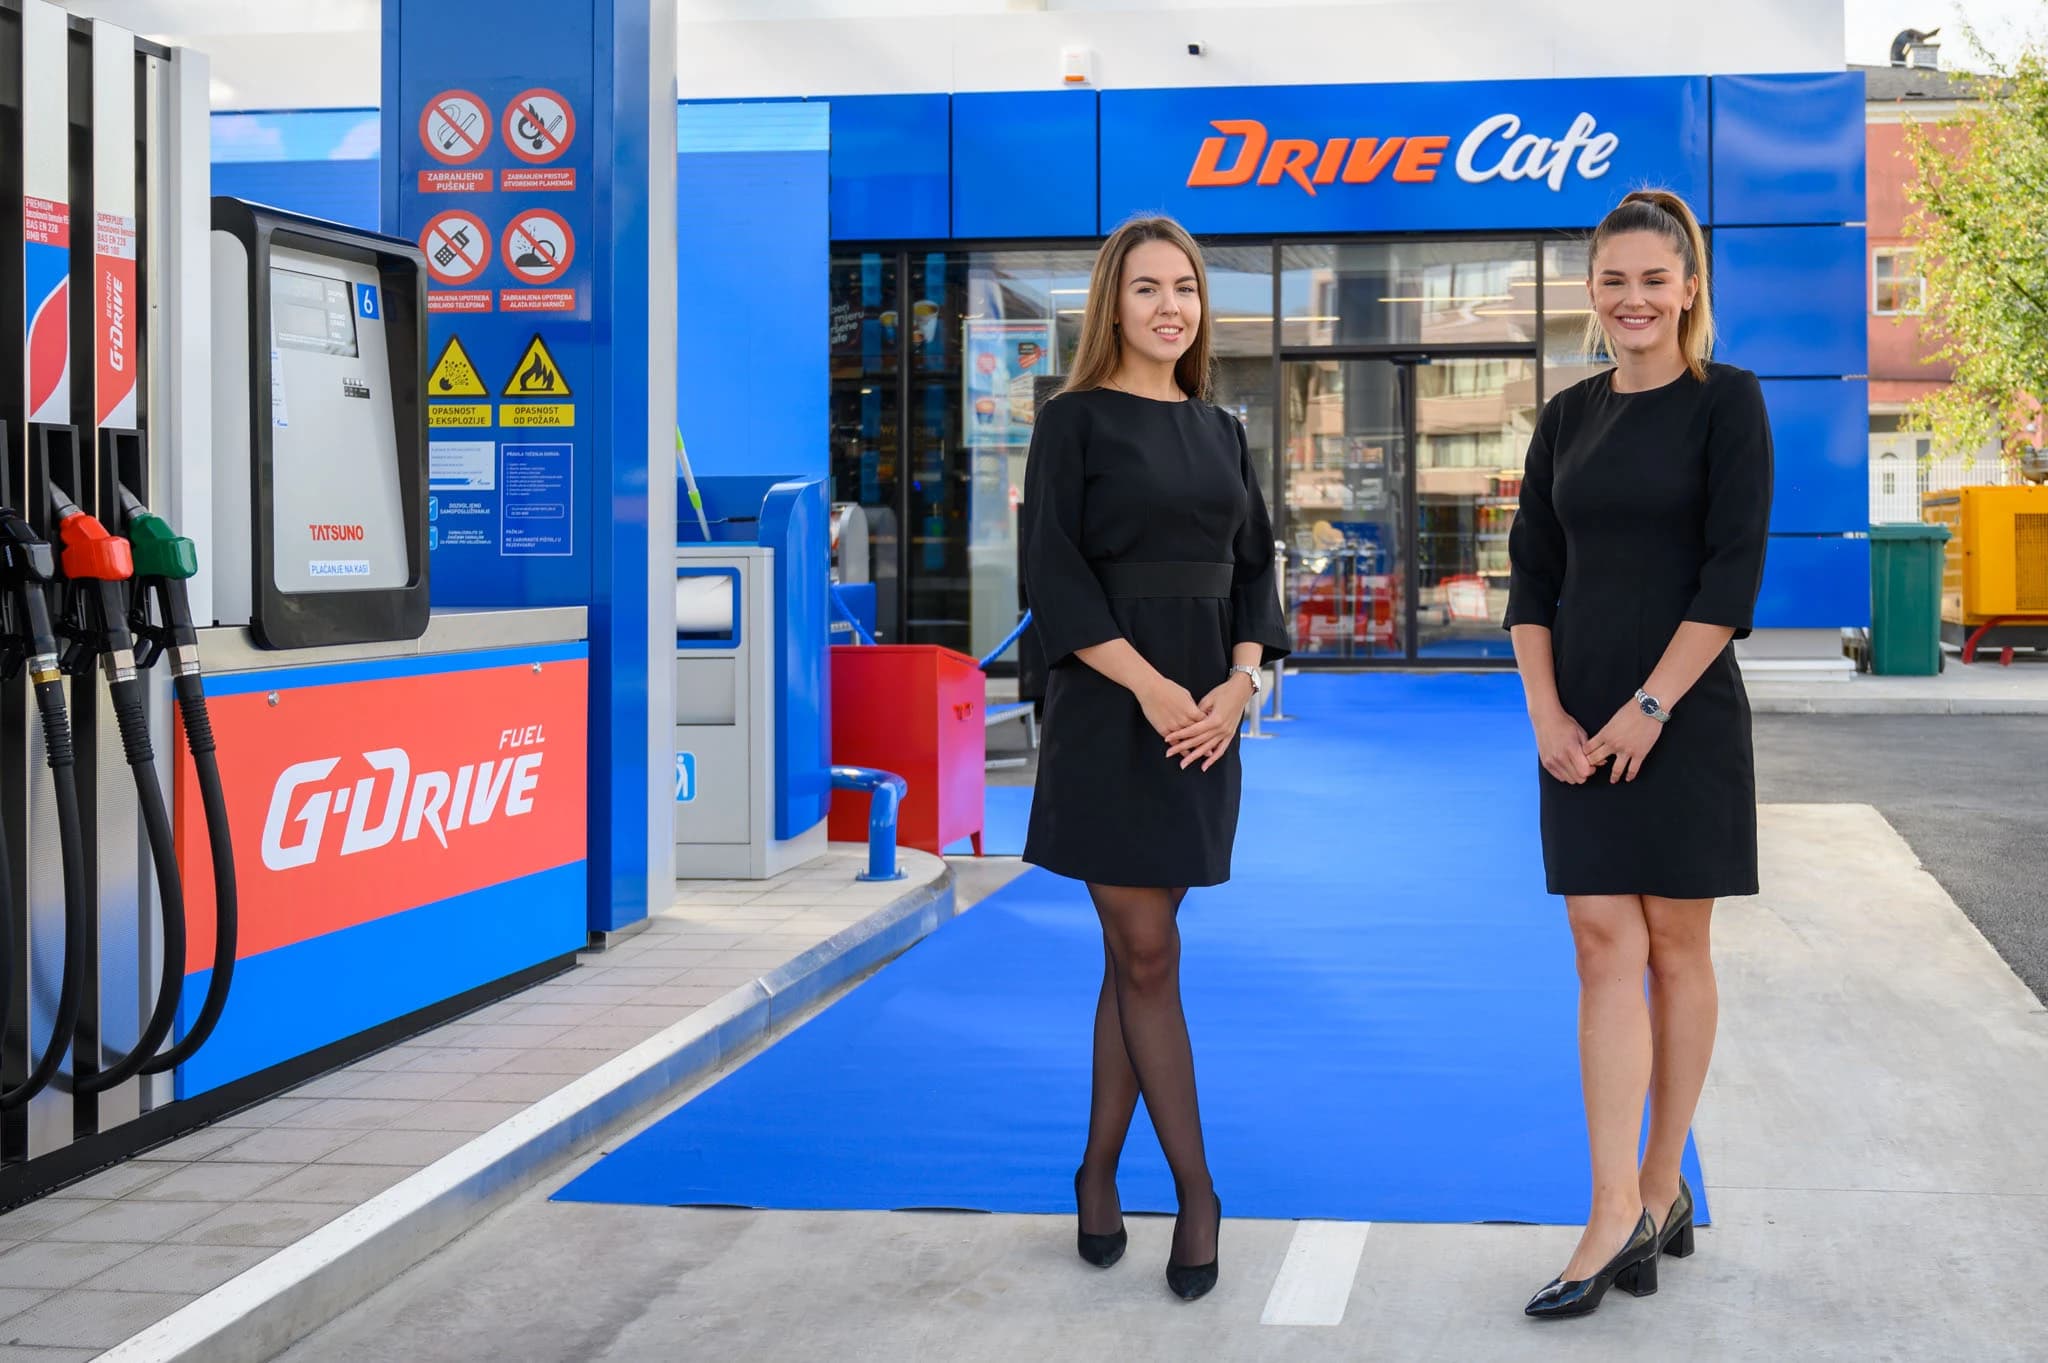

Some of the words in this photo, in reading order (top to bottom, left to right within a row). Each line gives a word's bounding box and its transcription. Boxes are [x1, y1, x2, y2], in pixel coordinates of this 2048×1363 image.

[1186, 119, 1450, 197] DRIVE
[1455, 112, 1619, 192] Cafe
[427, 172, 484, 181] ZABRANJENO
[543, 172, 570, 180] PRISTUP
[436, 181, 475, 191] PUŠENJE
[363, 289, 373, 314] 6
[458, 294, 490, 302] UPOTREBA
[541, 293, 573, 301] UPOTREBA
[432, 407, 476, 415] OPASNOST
[514, 406, 559, 414] OPASNOST
[436, 417, 486, 425] EKSPLOZIJE
[513, 417, 525, 425] OD
[527, 415, 560, 425] POŽARA
[309, 524, 364, 541] TATSUNO
[499, 724, 545, 750] FUEL
